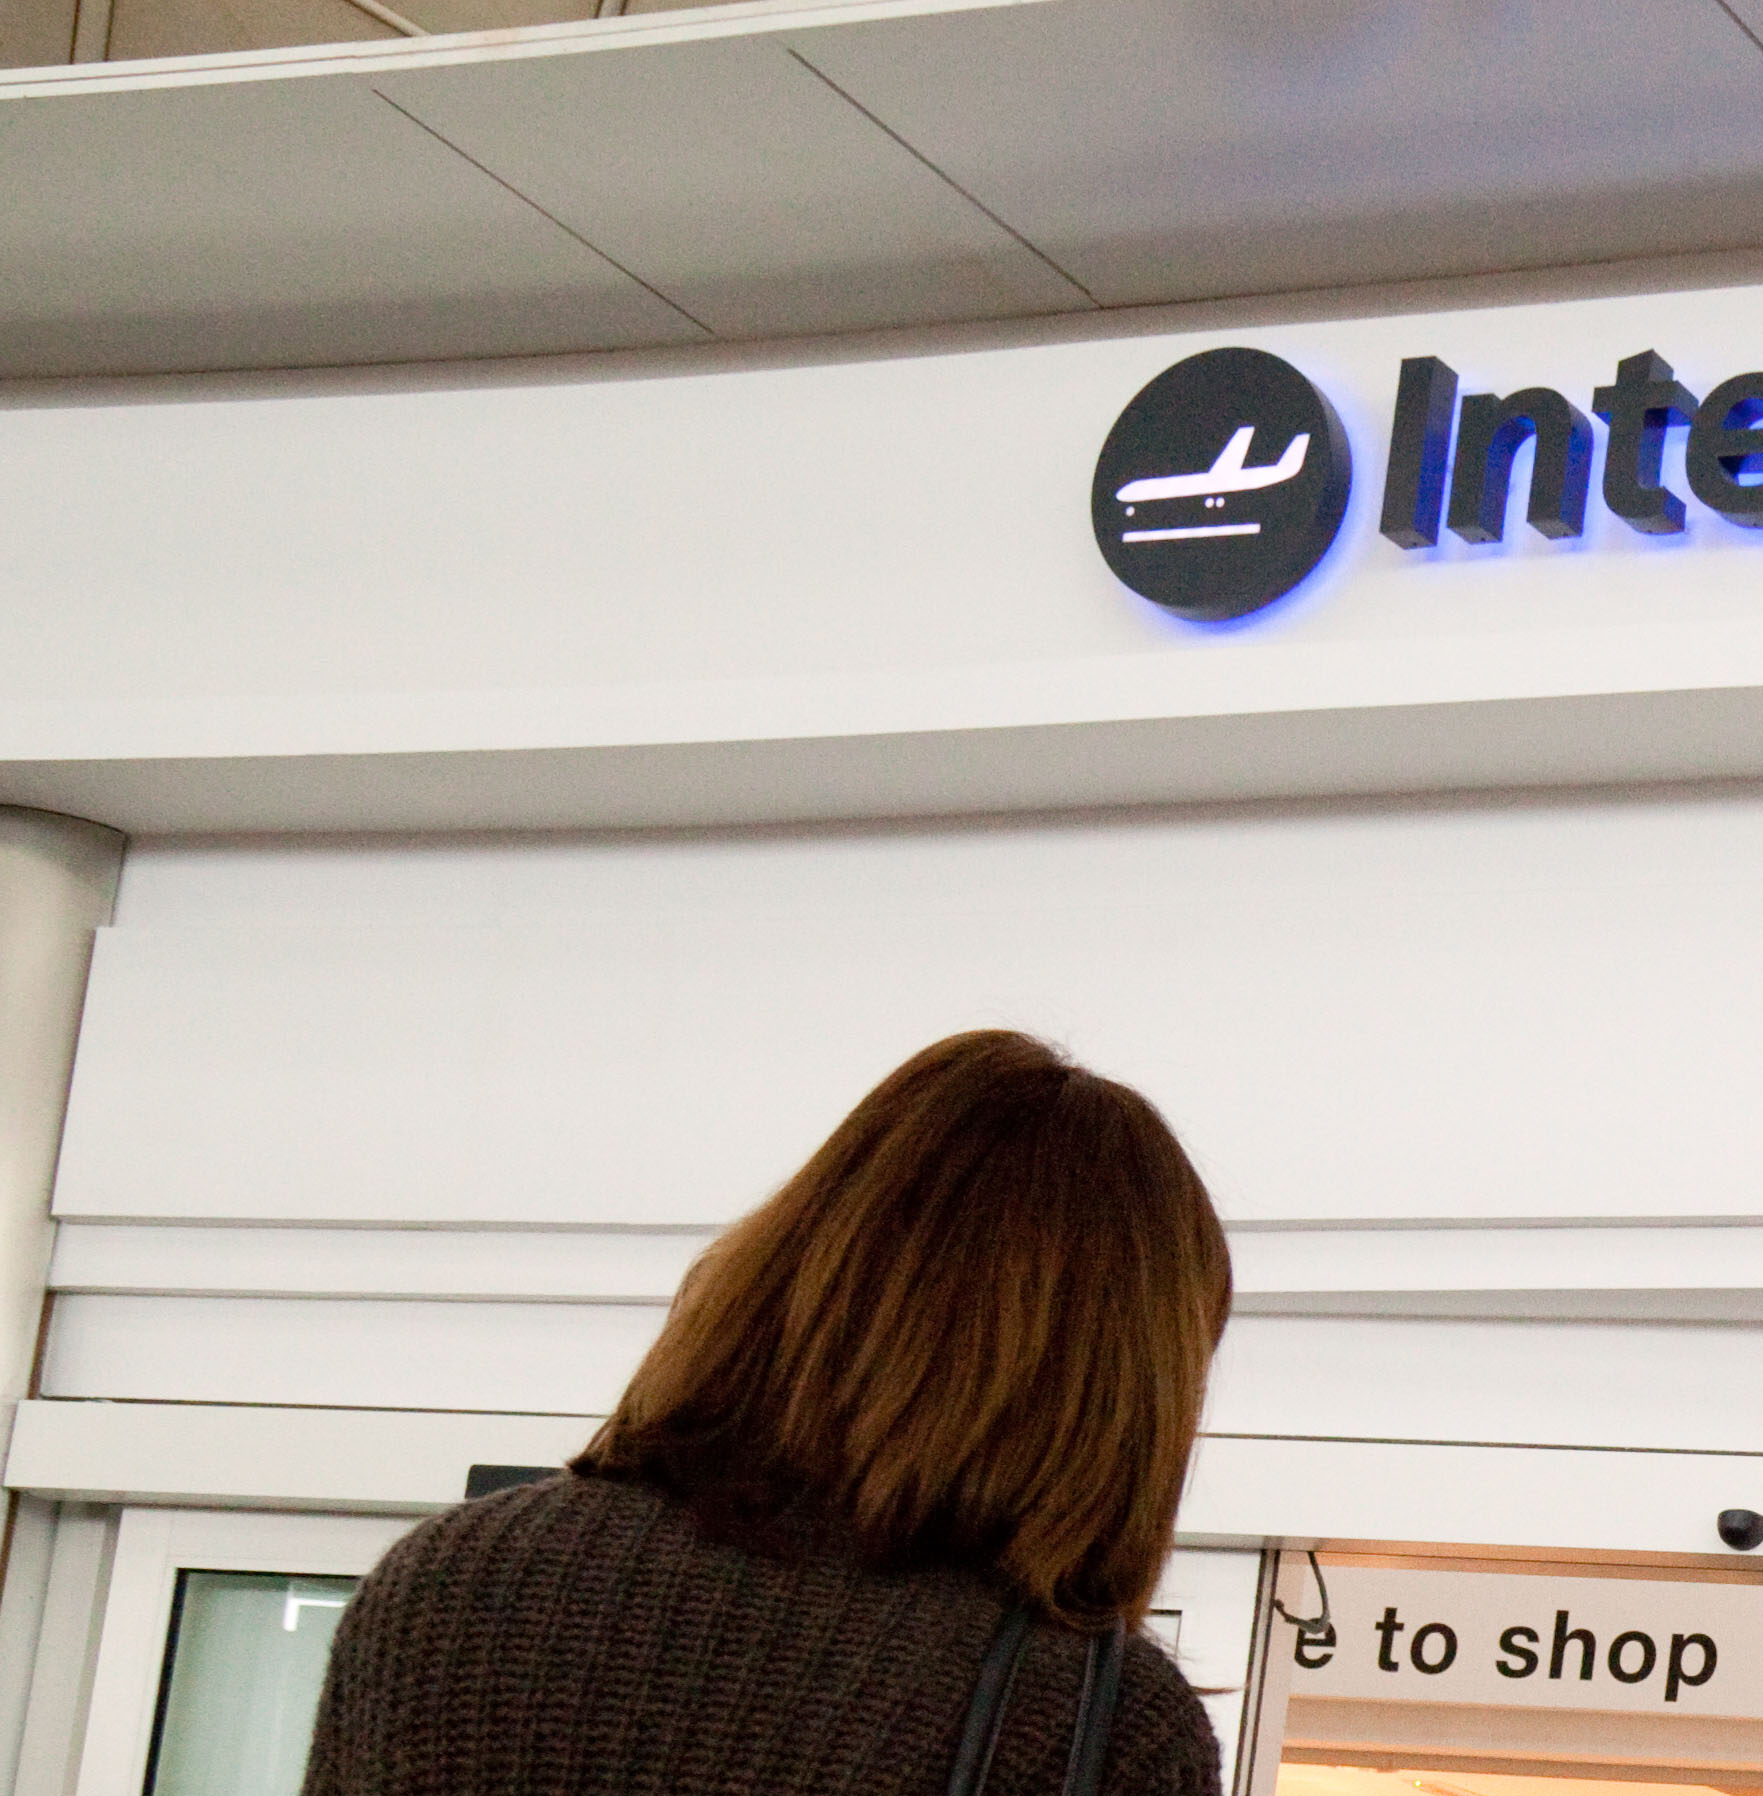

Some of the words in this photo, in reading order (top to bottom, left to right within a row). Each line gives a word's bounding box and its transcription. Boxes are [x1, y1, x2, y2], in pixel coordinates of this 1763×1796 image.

[1293, 1616, 1337, 1670] e
[1374, 1606, 1459, 1676] to
[1495, 1609, 1718, 1703] shop
